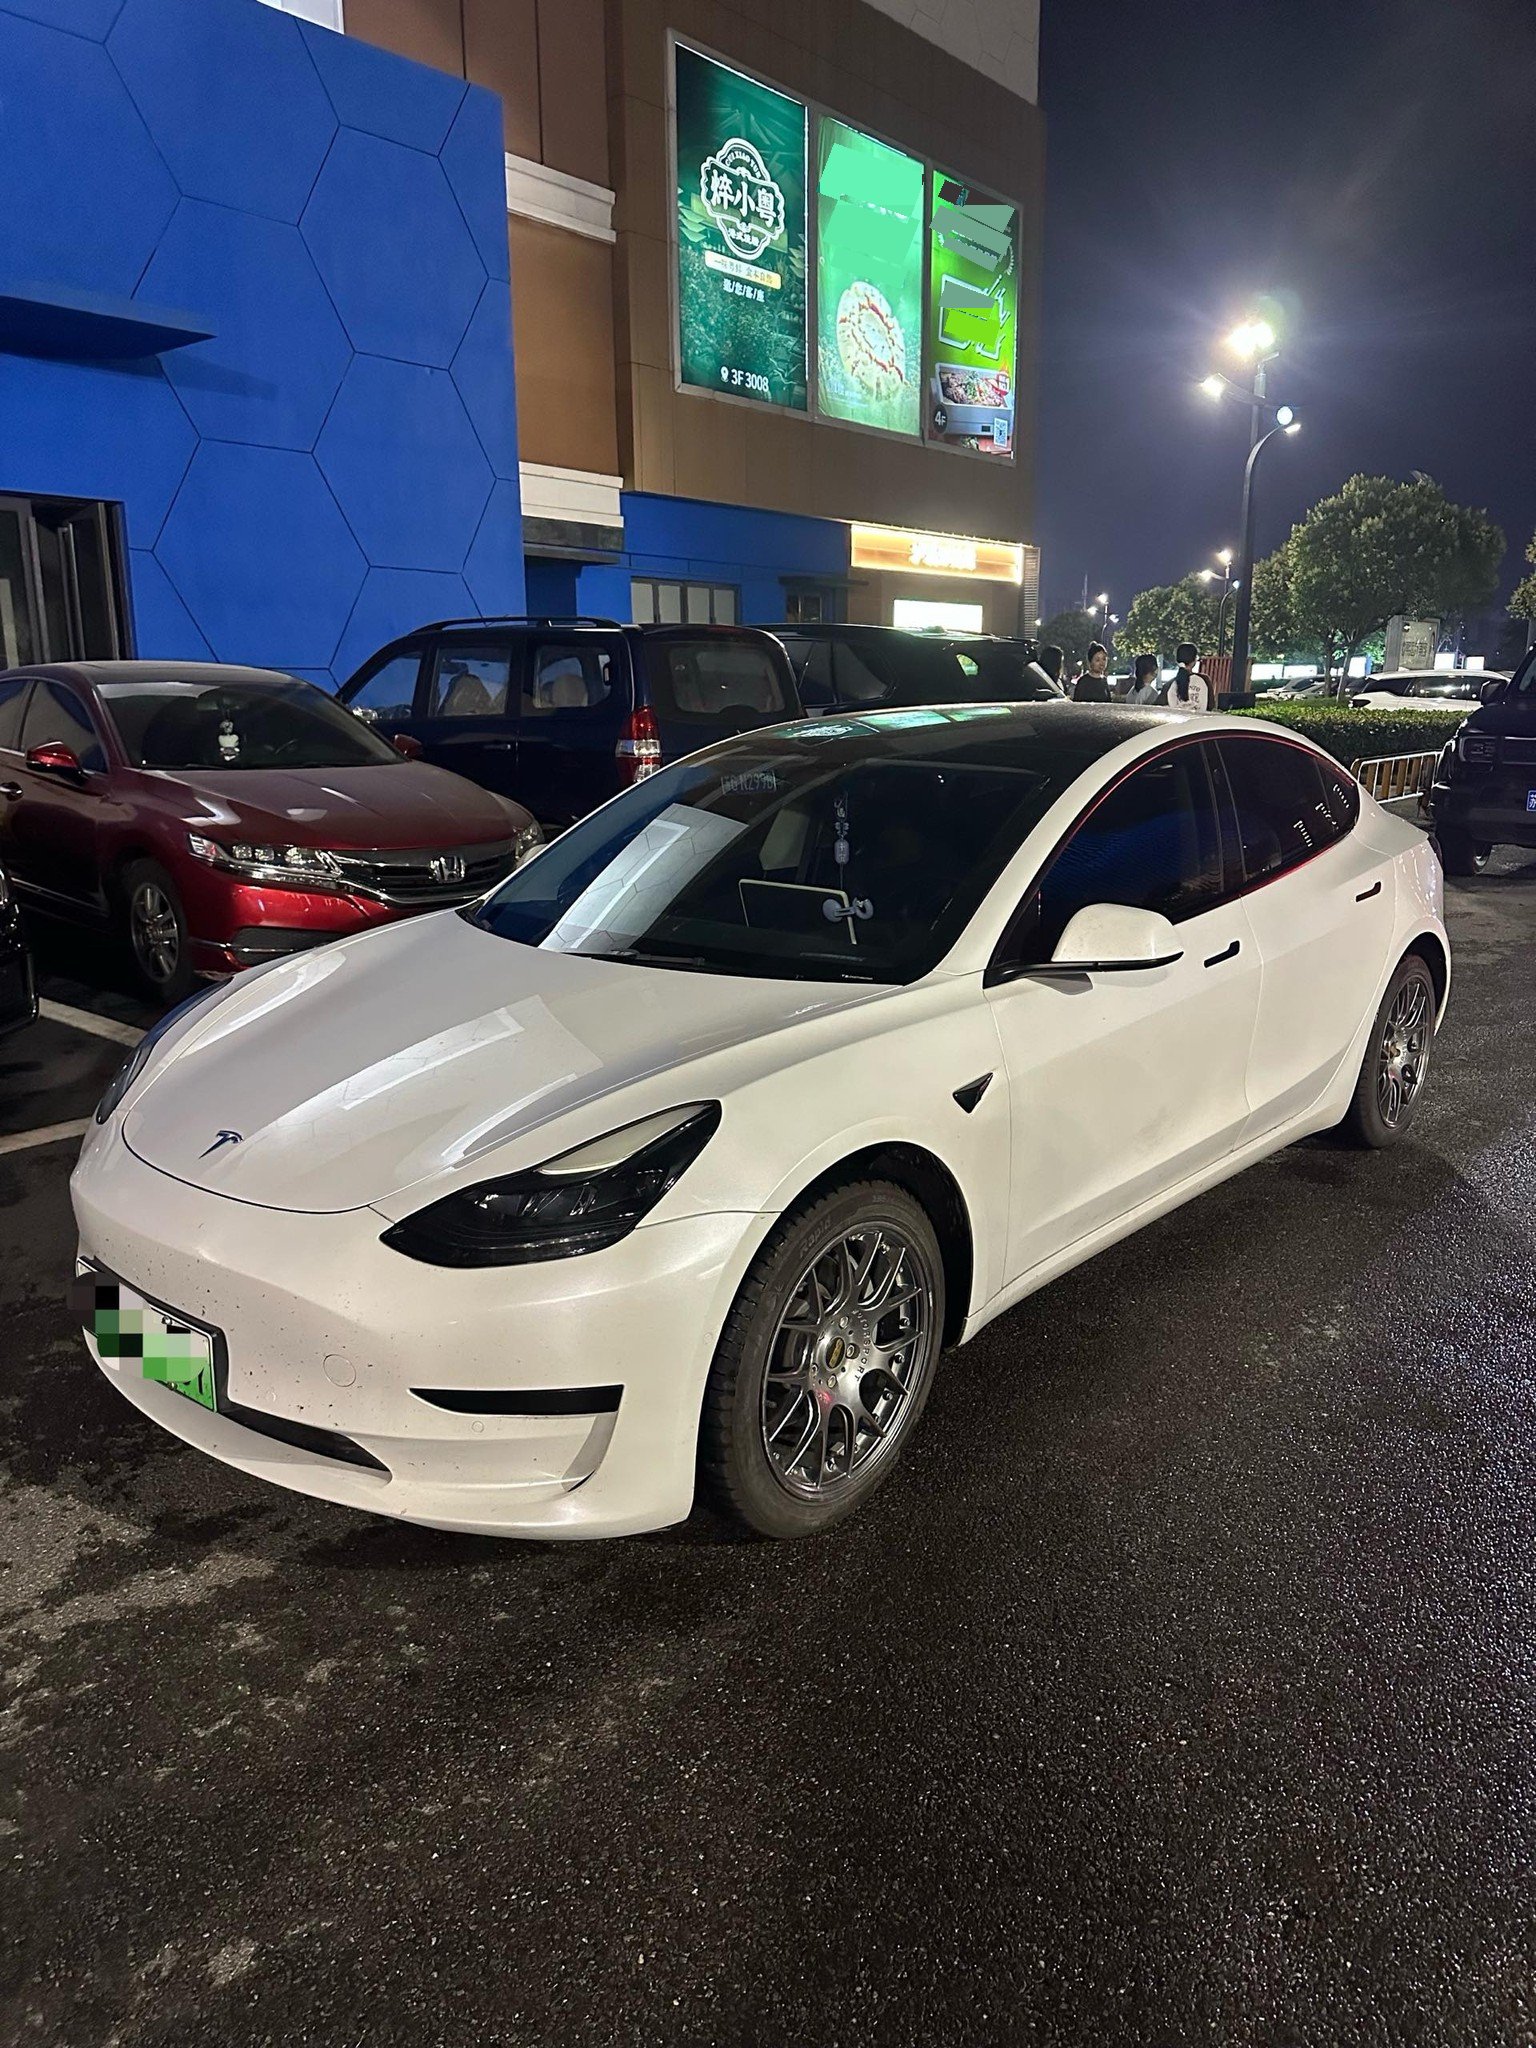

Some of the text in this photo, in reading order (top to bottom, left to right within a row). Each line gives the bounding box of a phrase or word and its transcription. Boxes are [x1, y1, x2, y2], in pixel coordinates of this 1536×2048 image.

[731, 369, 769, 391] 3F 3008
[935, 411, 946, 426] 4F
